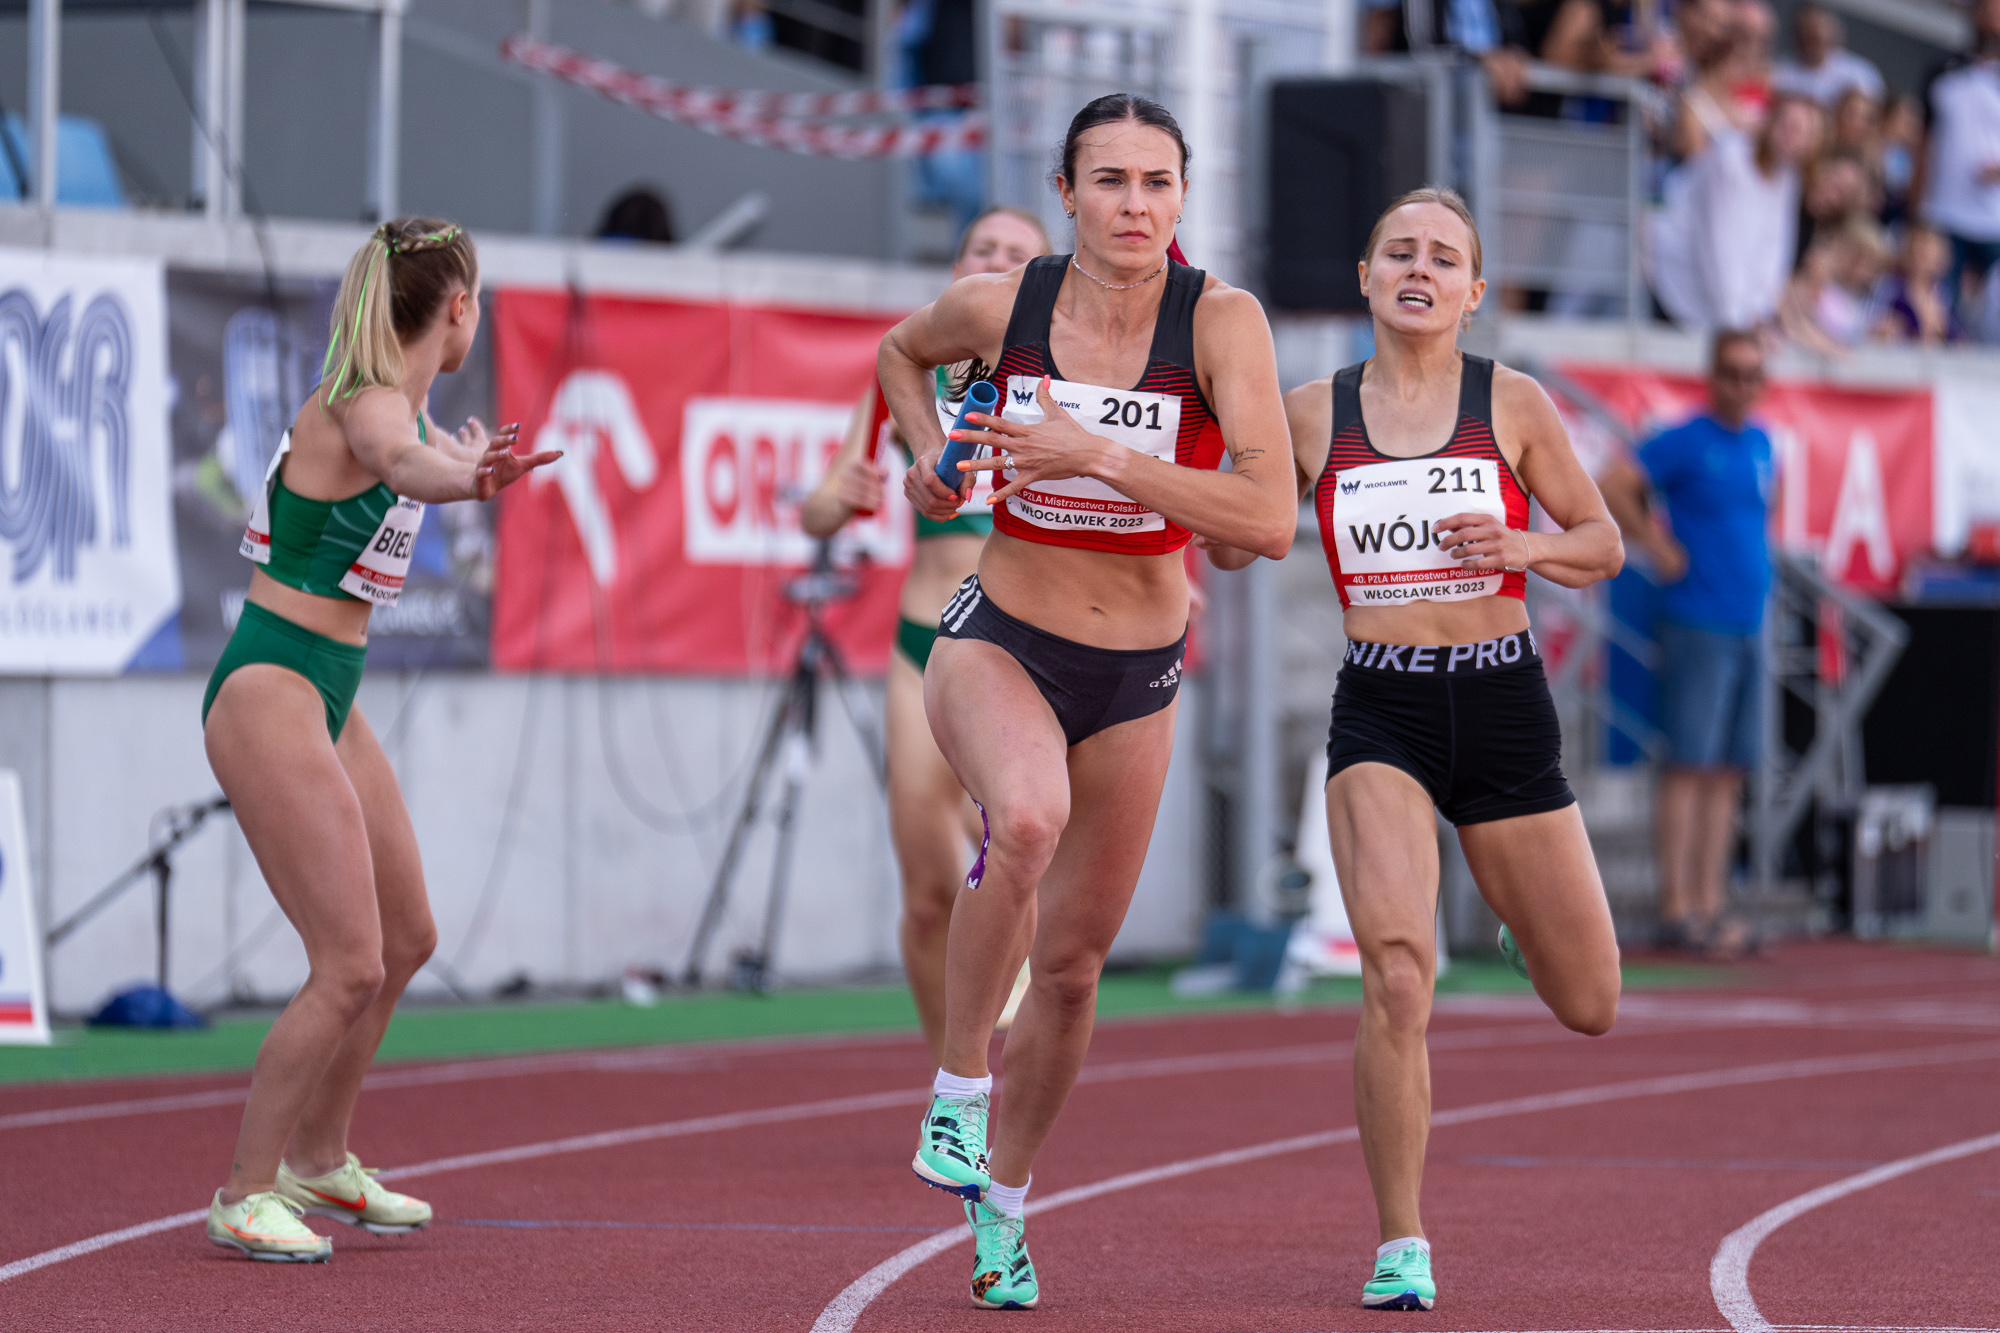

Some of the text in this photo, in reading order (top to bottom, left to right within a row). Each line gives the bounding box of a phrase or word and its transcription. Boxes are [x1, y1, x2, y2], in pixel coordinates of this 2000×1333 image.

[1099, 397, 1162, 430] 201
[1364, 479, 1408, 489] WŁOCŁAWEK
[1427, 466, 1486, 494] 211
[1022, 490, 1042, 503] PZLA
[1044, 496, 1105, 511] Mistrzostwa
[1107, 502, 1137, 513] Polski
[1020, 501, 1144, 528] WŁOCŁAWEK 2023
[1352, 575, 1366, 584] 40.
[1368, 574, 1388, 584] PZLA
[1390, 571, 1448, 583] Mistrzostwa
[1450, 569, 1476, 578] Polski
[1363, 581, 1485, 600] WŁOCŁAWEK 2023
[1346, 640, 1439, 672] NIKE
[1447, 635, 1521, 672] PRO
